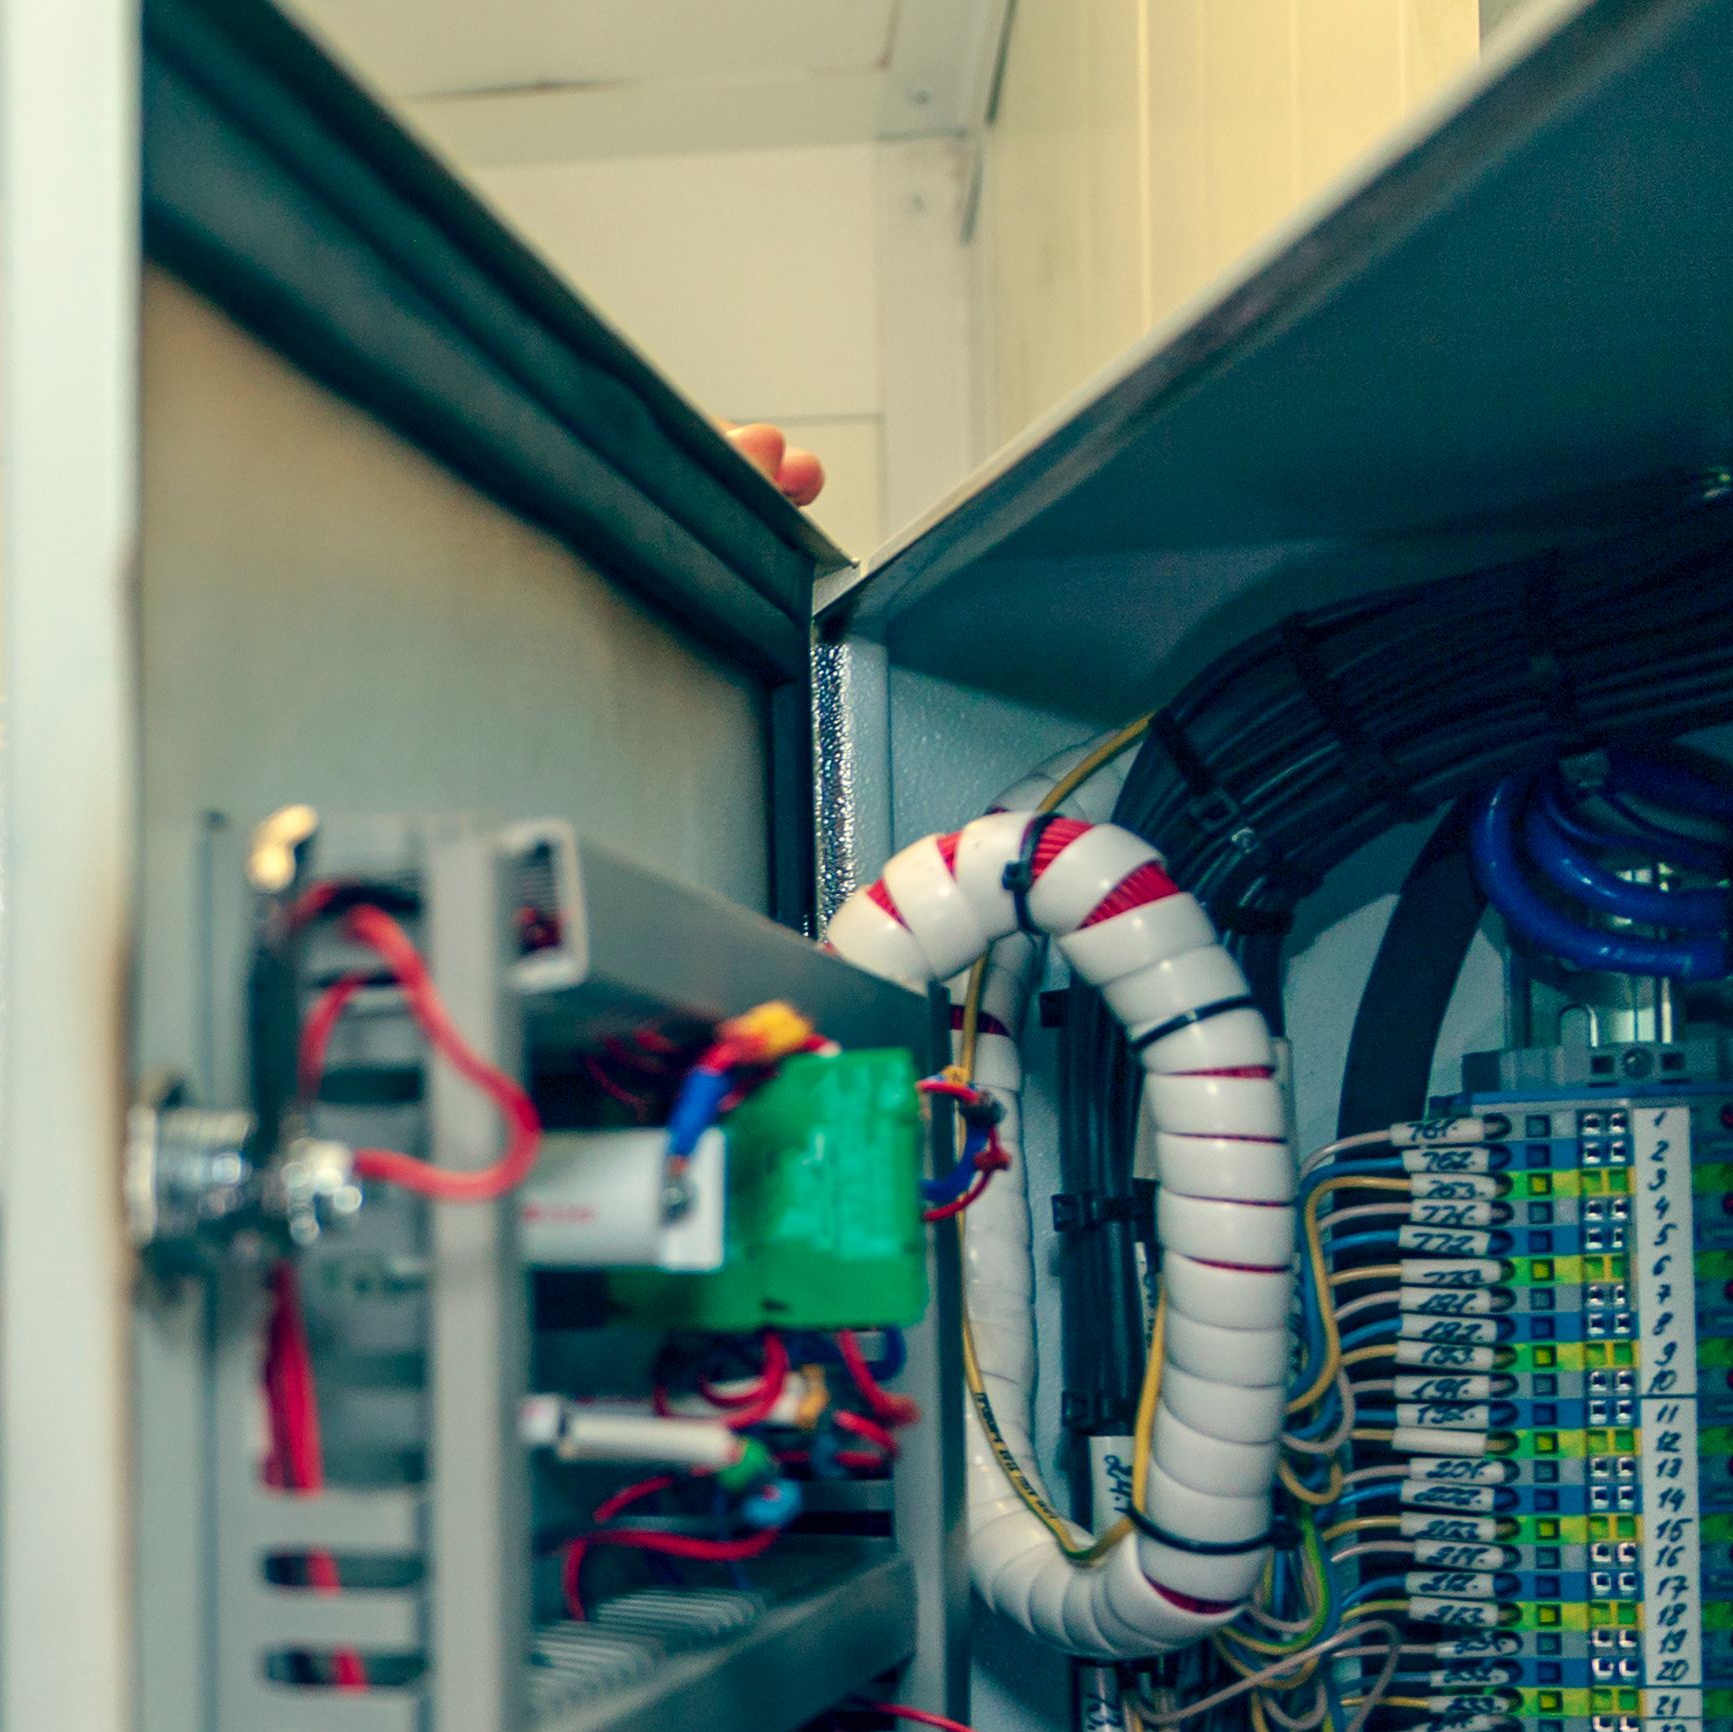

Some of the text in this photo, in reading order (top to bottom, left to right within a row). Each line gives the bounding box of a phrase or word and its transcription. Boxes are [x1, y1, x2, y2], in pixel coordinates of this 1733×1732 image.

[1654, 1111, 1666, 1126] 1
[1651, 1140, 1669, 1162] 2
[1649, 1168, 1667, 1191] 3
[1655, 1196, 1670, 1219] 4
[1654, 1223, 1677, 1246] 5
[1653, 1255, 1672, 1276] 6
[1657, 1284, 1671, 1304] 7
[1653, 1312, 1673, 1336] 8
[1655, 1342, 1677, 1367] 9
[1650, 1370, 1677, 1394] 10
[1657, 1405, 1679, 1422] 11
[1656, 1431, 1682, 1453] 12
[1657, 1458, 1683, 1478] 13
[1659, 1487, 1686, 1512] 14
[1657, 1518, 1693, 1543] 15
[1656, 1546, 1685, 1567] 16
[1657, 1575, 1689, 1600] 17
[1657, 1603, 1687, 1627] 18
[1659, 1629, 1687, 1653] 19
[1656, 1659, 1689, 1682] 20
[1655, 1696, 1680, 1716] 21
